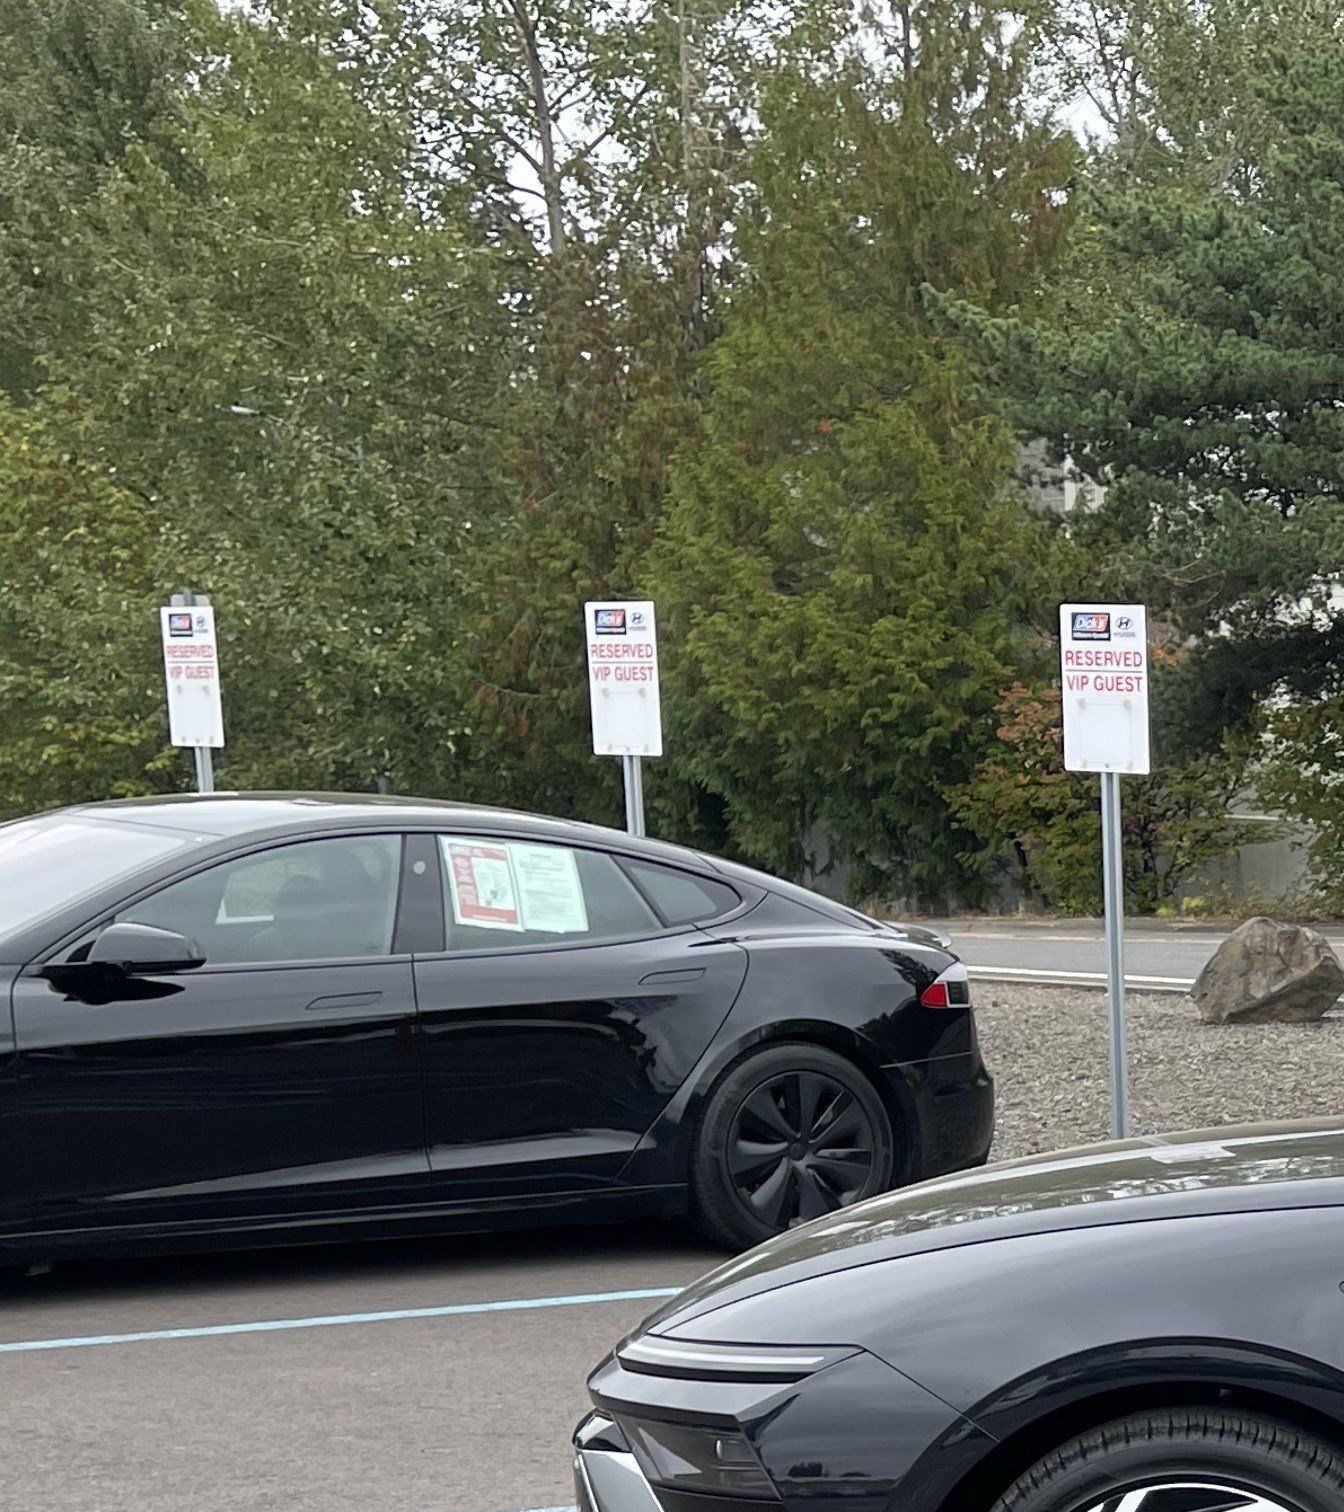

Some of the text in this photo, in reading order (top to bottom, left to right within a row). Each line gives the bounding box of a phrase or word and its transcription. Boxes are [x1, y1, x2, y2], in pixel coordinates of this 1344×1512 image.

[590, 643, 654, 659] RESERVED
[1065, 650, 1143, 667] RESERVED
[592, 666, 654, 682] VIP GUEST
[1066, 675, 1143, 692] VIP GUEST
